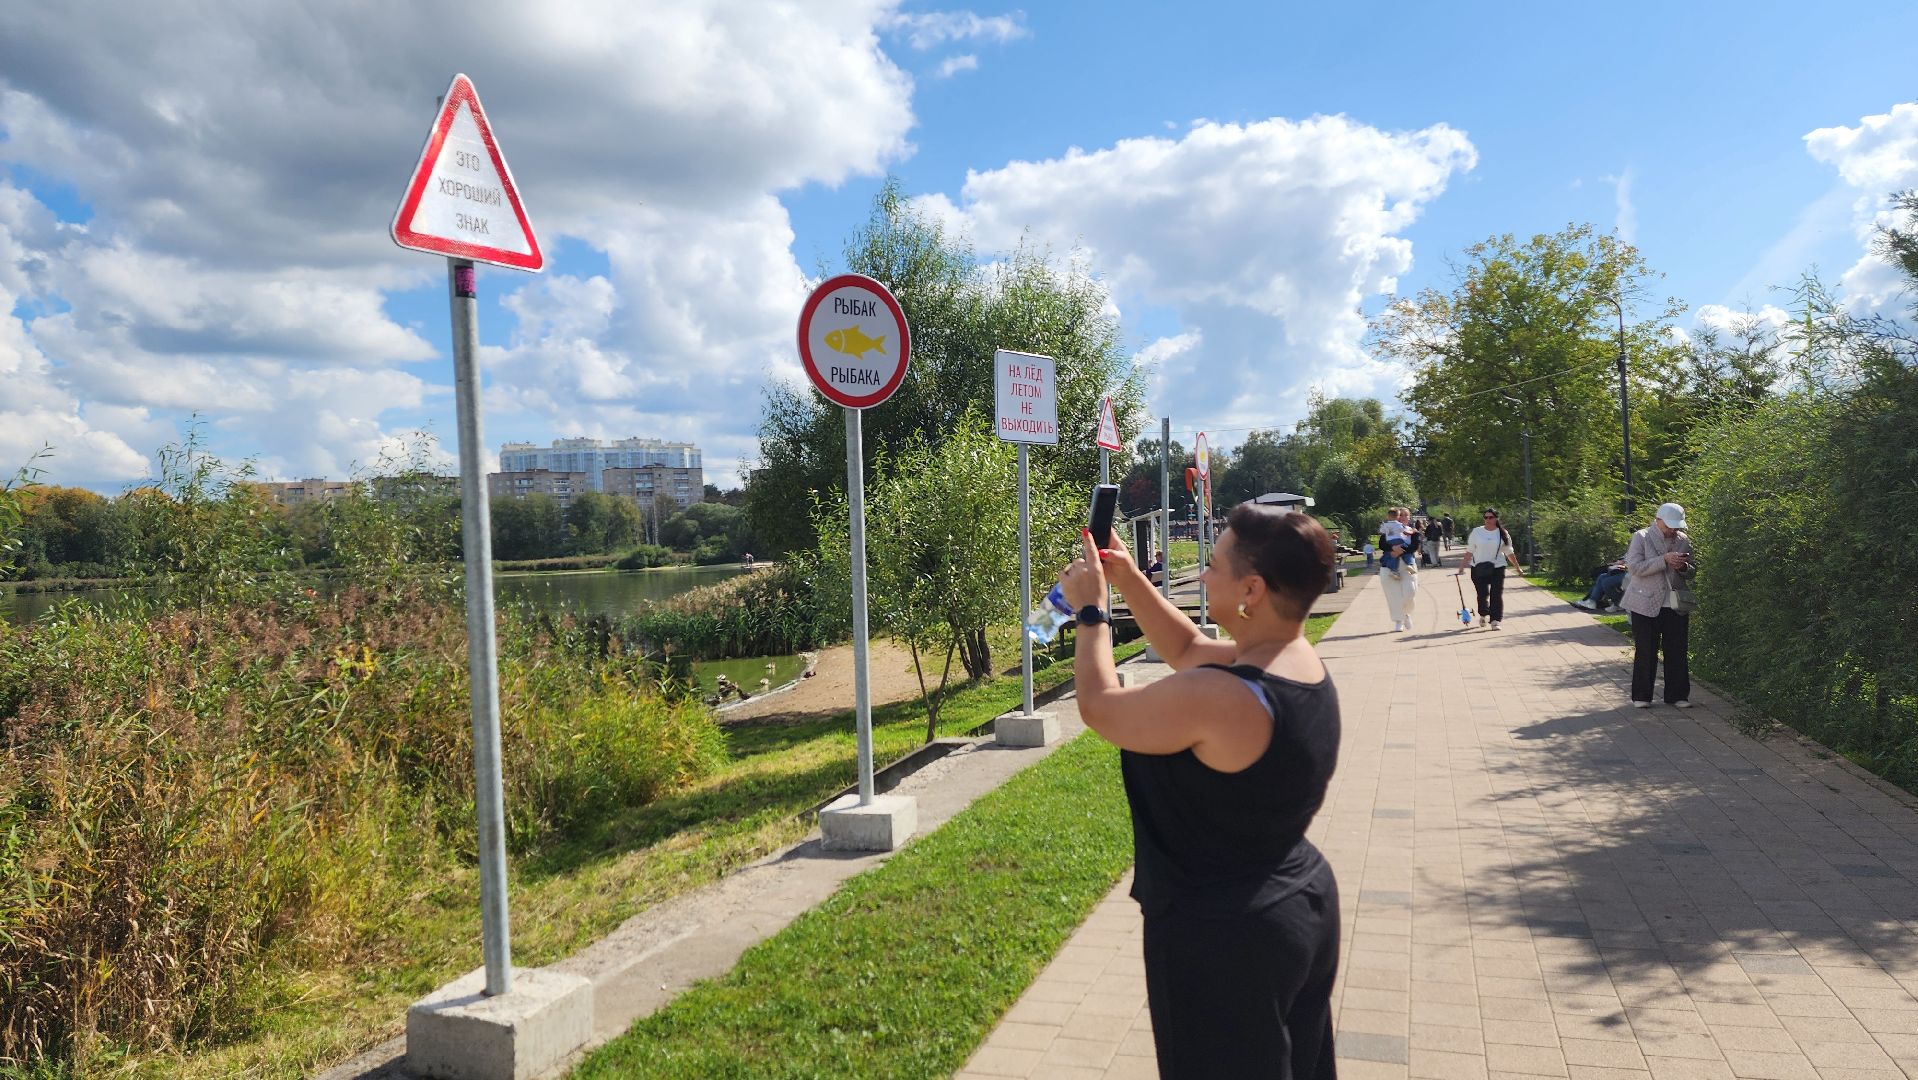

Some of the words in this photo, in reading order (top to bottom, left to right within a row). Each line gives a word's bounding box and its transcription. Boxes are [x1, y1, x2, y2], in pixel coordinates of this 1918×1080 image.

[456, 151, 480, 171] ЭТО
[438, 177, 501, 206] ХОРОШИЙ
[455, 213, 490, 234] ЗНАК
[834, 297, 876, 317] РЫБАК
[831, 366, 881, 386] РЫБАКА
[1009, 364, 1021, 378] НА
[1024, 364, 1043, 383] ЛЁД
[1011, 383, 1042, 398] ЛЕТОМ
[1021, 401, 1033, 415] НЕ
[1001, 417, 1054, 434] ВЫХОДИТЬ
